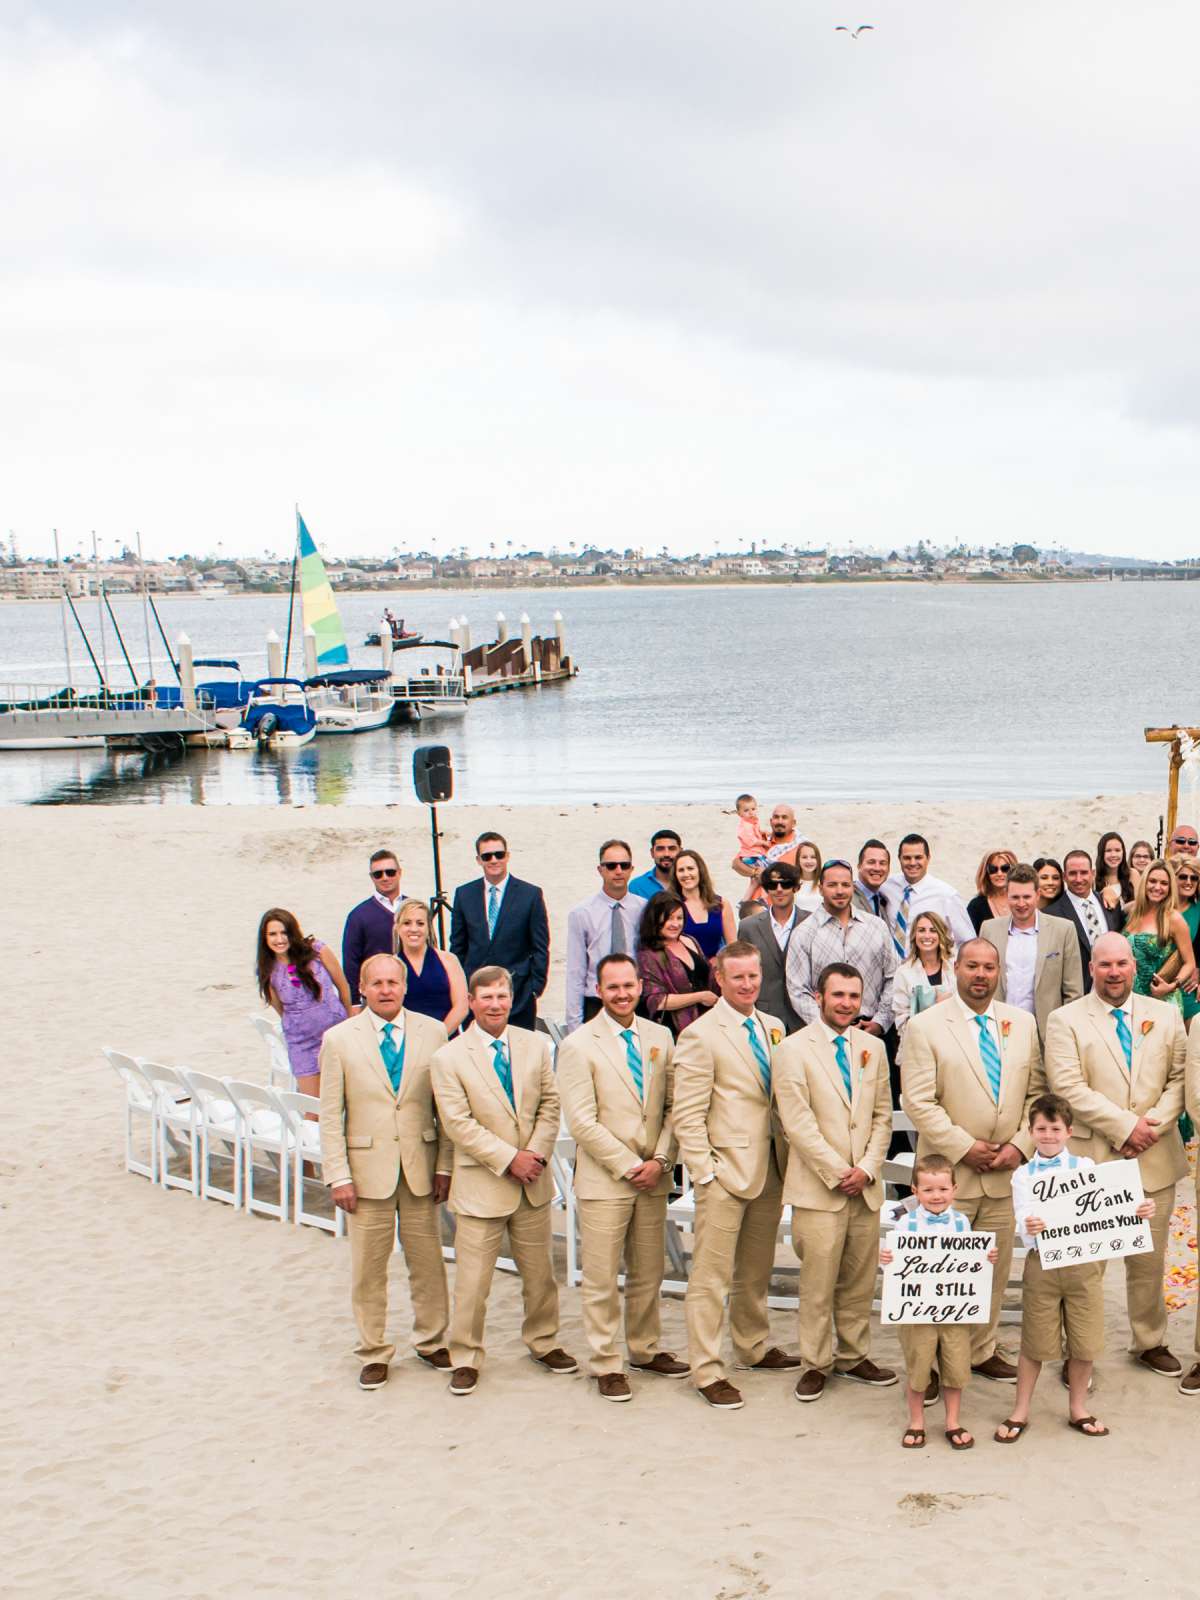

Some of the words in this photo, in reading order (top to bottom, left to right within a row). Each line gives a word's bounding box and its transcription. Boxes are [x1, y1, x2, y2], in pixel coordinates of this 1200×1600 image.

[1032, 1172, 1097, 1202] Uncle
[1075, 1188, 1134, 1217] Hank
[1073, 1218, 1115, 1235] comes
[897, 1235, 938, 1250] DONT
[940, 1236, 992, 1250] WORRY
[893, 1253, 983, 1280] Ladies
[901, 1283, 922, 1297] IM
[935, 1282, 976, 1297] STILL
[888, 1301, 980, 1323] Single
